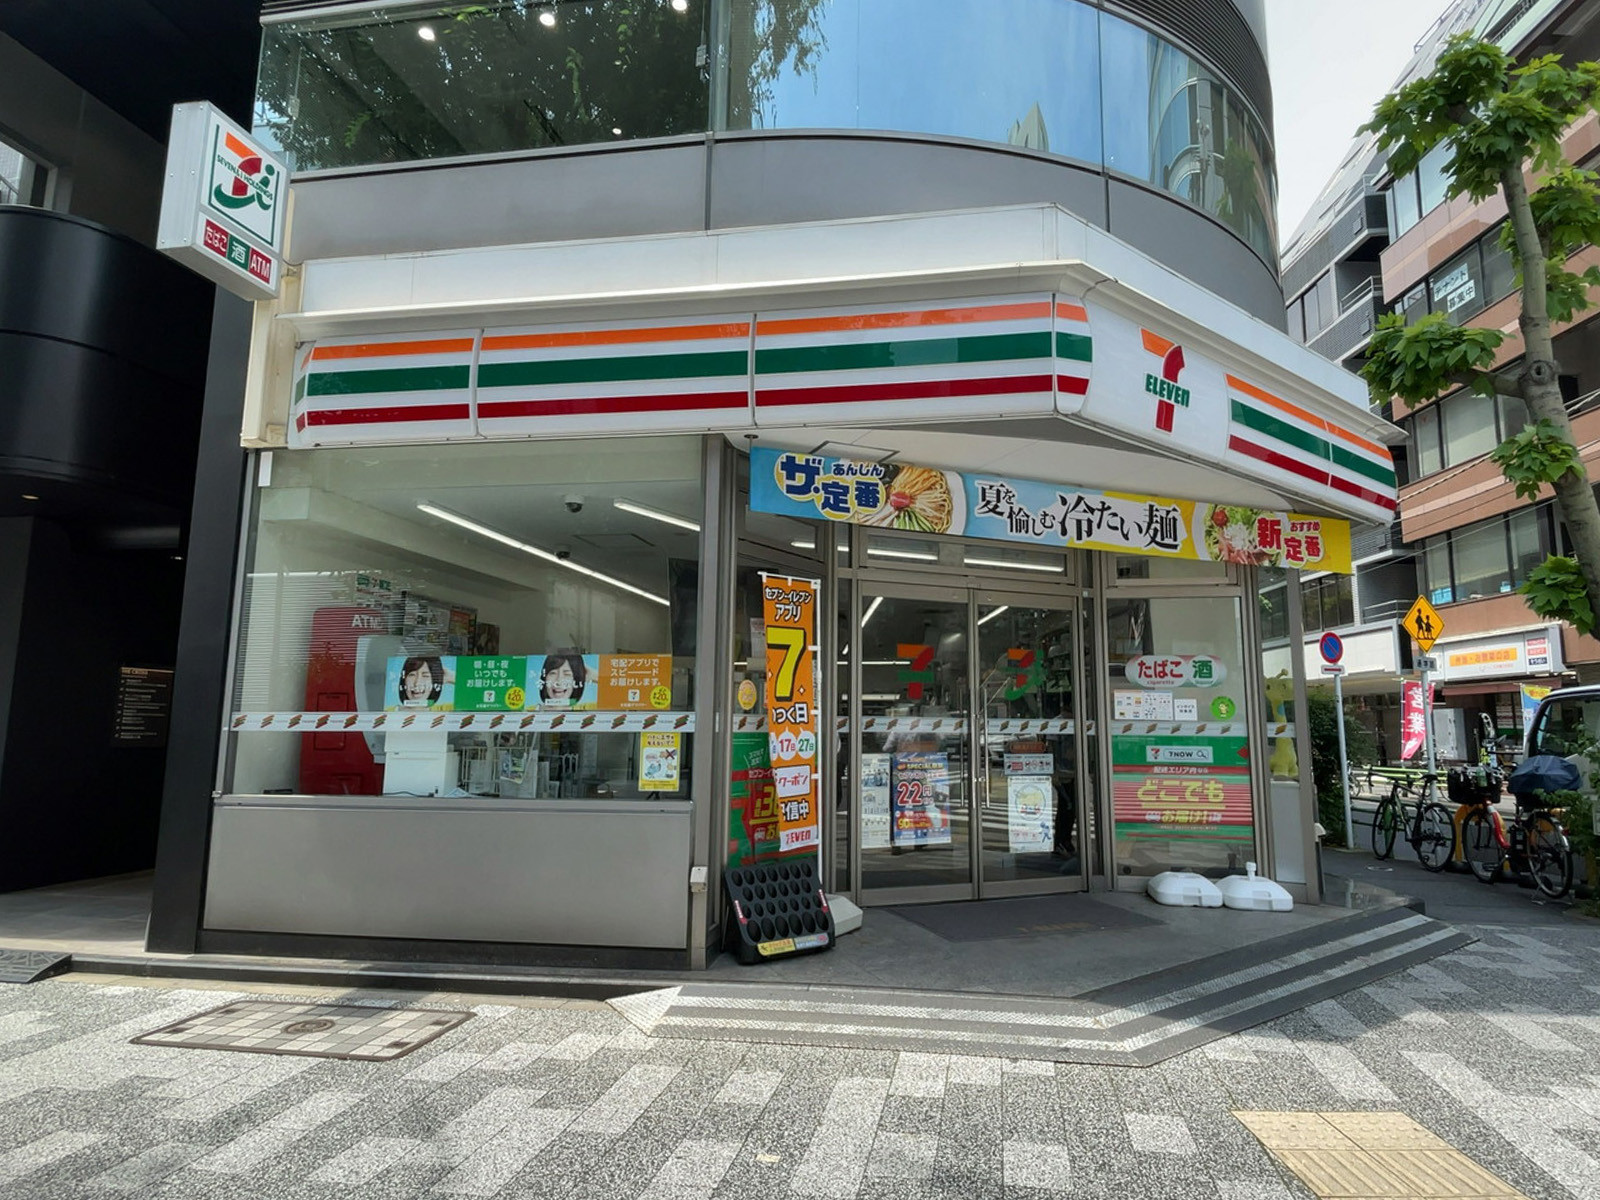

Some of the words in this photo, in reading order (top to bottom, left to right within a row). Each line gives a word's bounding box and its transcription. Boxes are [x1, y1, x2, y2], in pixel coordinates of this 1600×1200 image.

[205, 226, 228, 252] たばこ
[231, 241, 247, 264] 酒
[250, 253, 271, 279] ATM
[1435, 270, 1467, 298] テナント
[833, 463, 884, 477] あんしん
[781, 455, 881, 513] ザ・定番
[1290, 521, 1320, 532] おすすめ
[1257, 517, 1321, 563] 新定番
[775, 602, 802, 622] アプリ
[766, 625, 806, 701] 7
[1138, 659, 1184, 678] たばこ
[1192, 660, 1213, 678] 酒
[474, 670, 508, 678] いつでも
[779, 738, 797, 753] 17日
[797, 739, 815, 753] 27日
[778, 772, 809, 788] クーポン
[1136, 779, 1225, 803] どこでも
